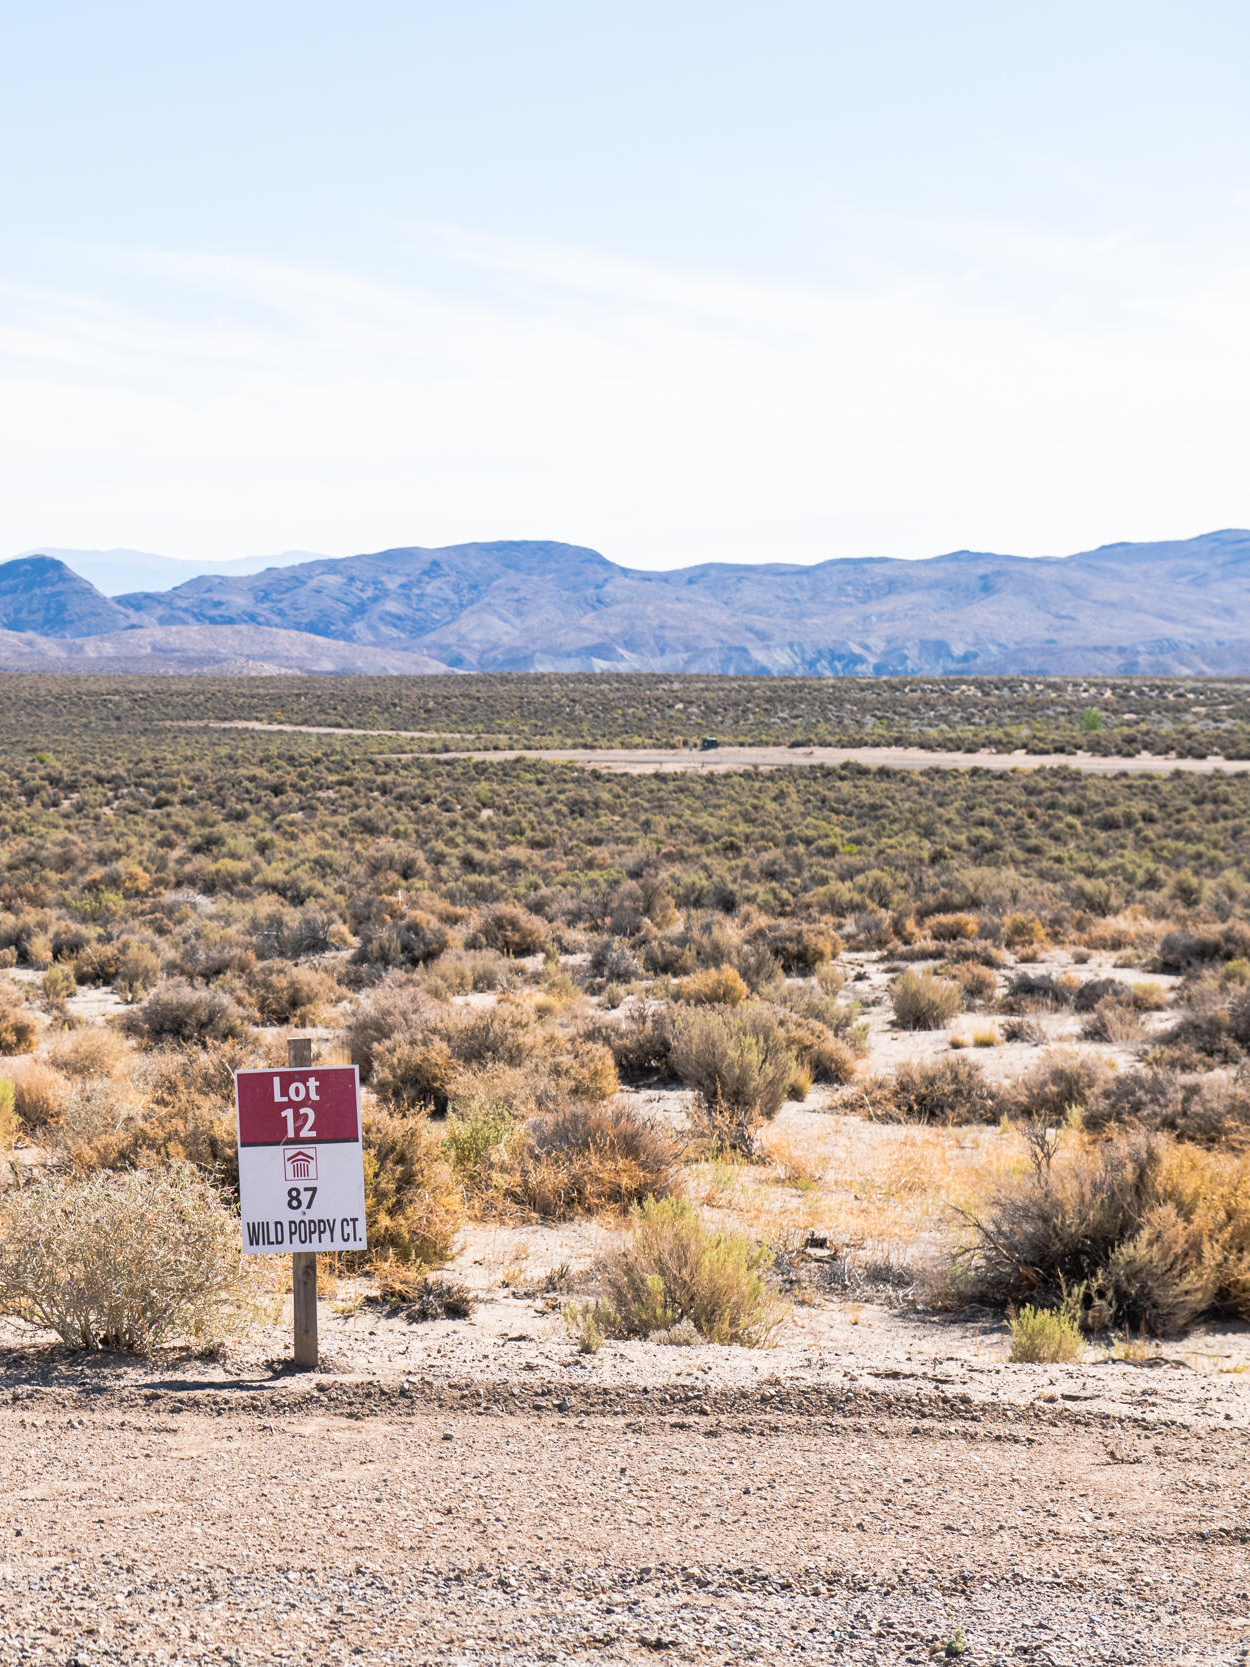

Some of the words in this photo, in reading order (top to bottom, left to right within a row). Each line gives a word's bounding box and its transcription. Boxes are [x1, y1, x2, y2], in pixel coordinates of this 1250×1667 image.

[273, 1076, 320, 1102] Lot
[281, 1107, 316, 1138] 12
[287, 1187, 318, 1210] 87
[247, 1220, 284, 1246] WILD
[289, 1218, 336, 1244] POPPY
[341, 1218, 362, 1242] CT.
